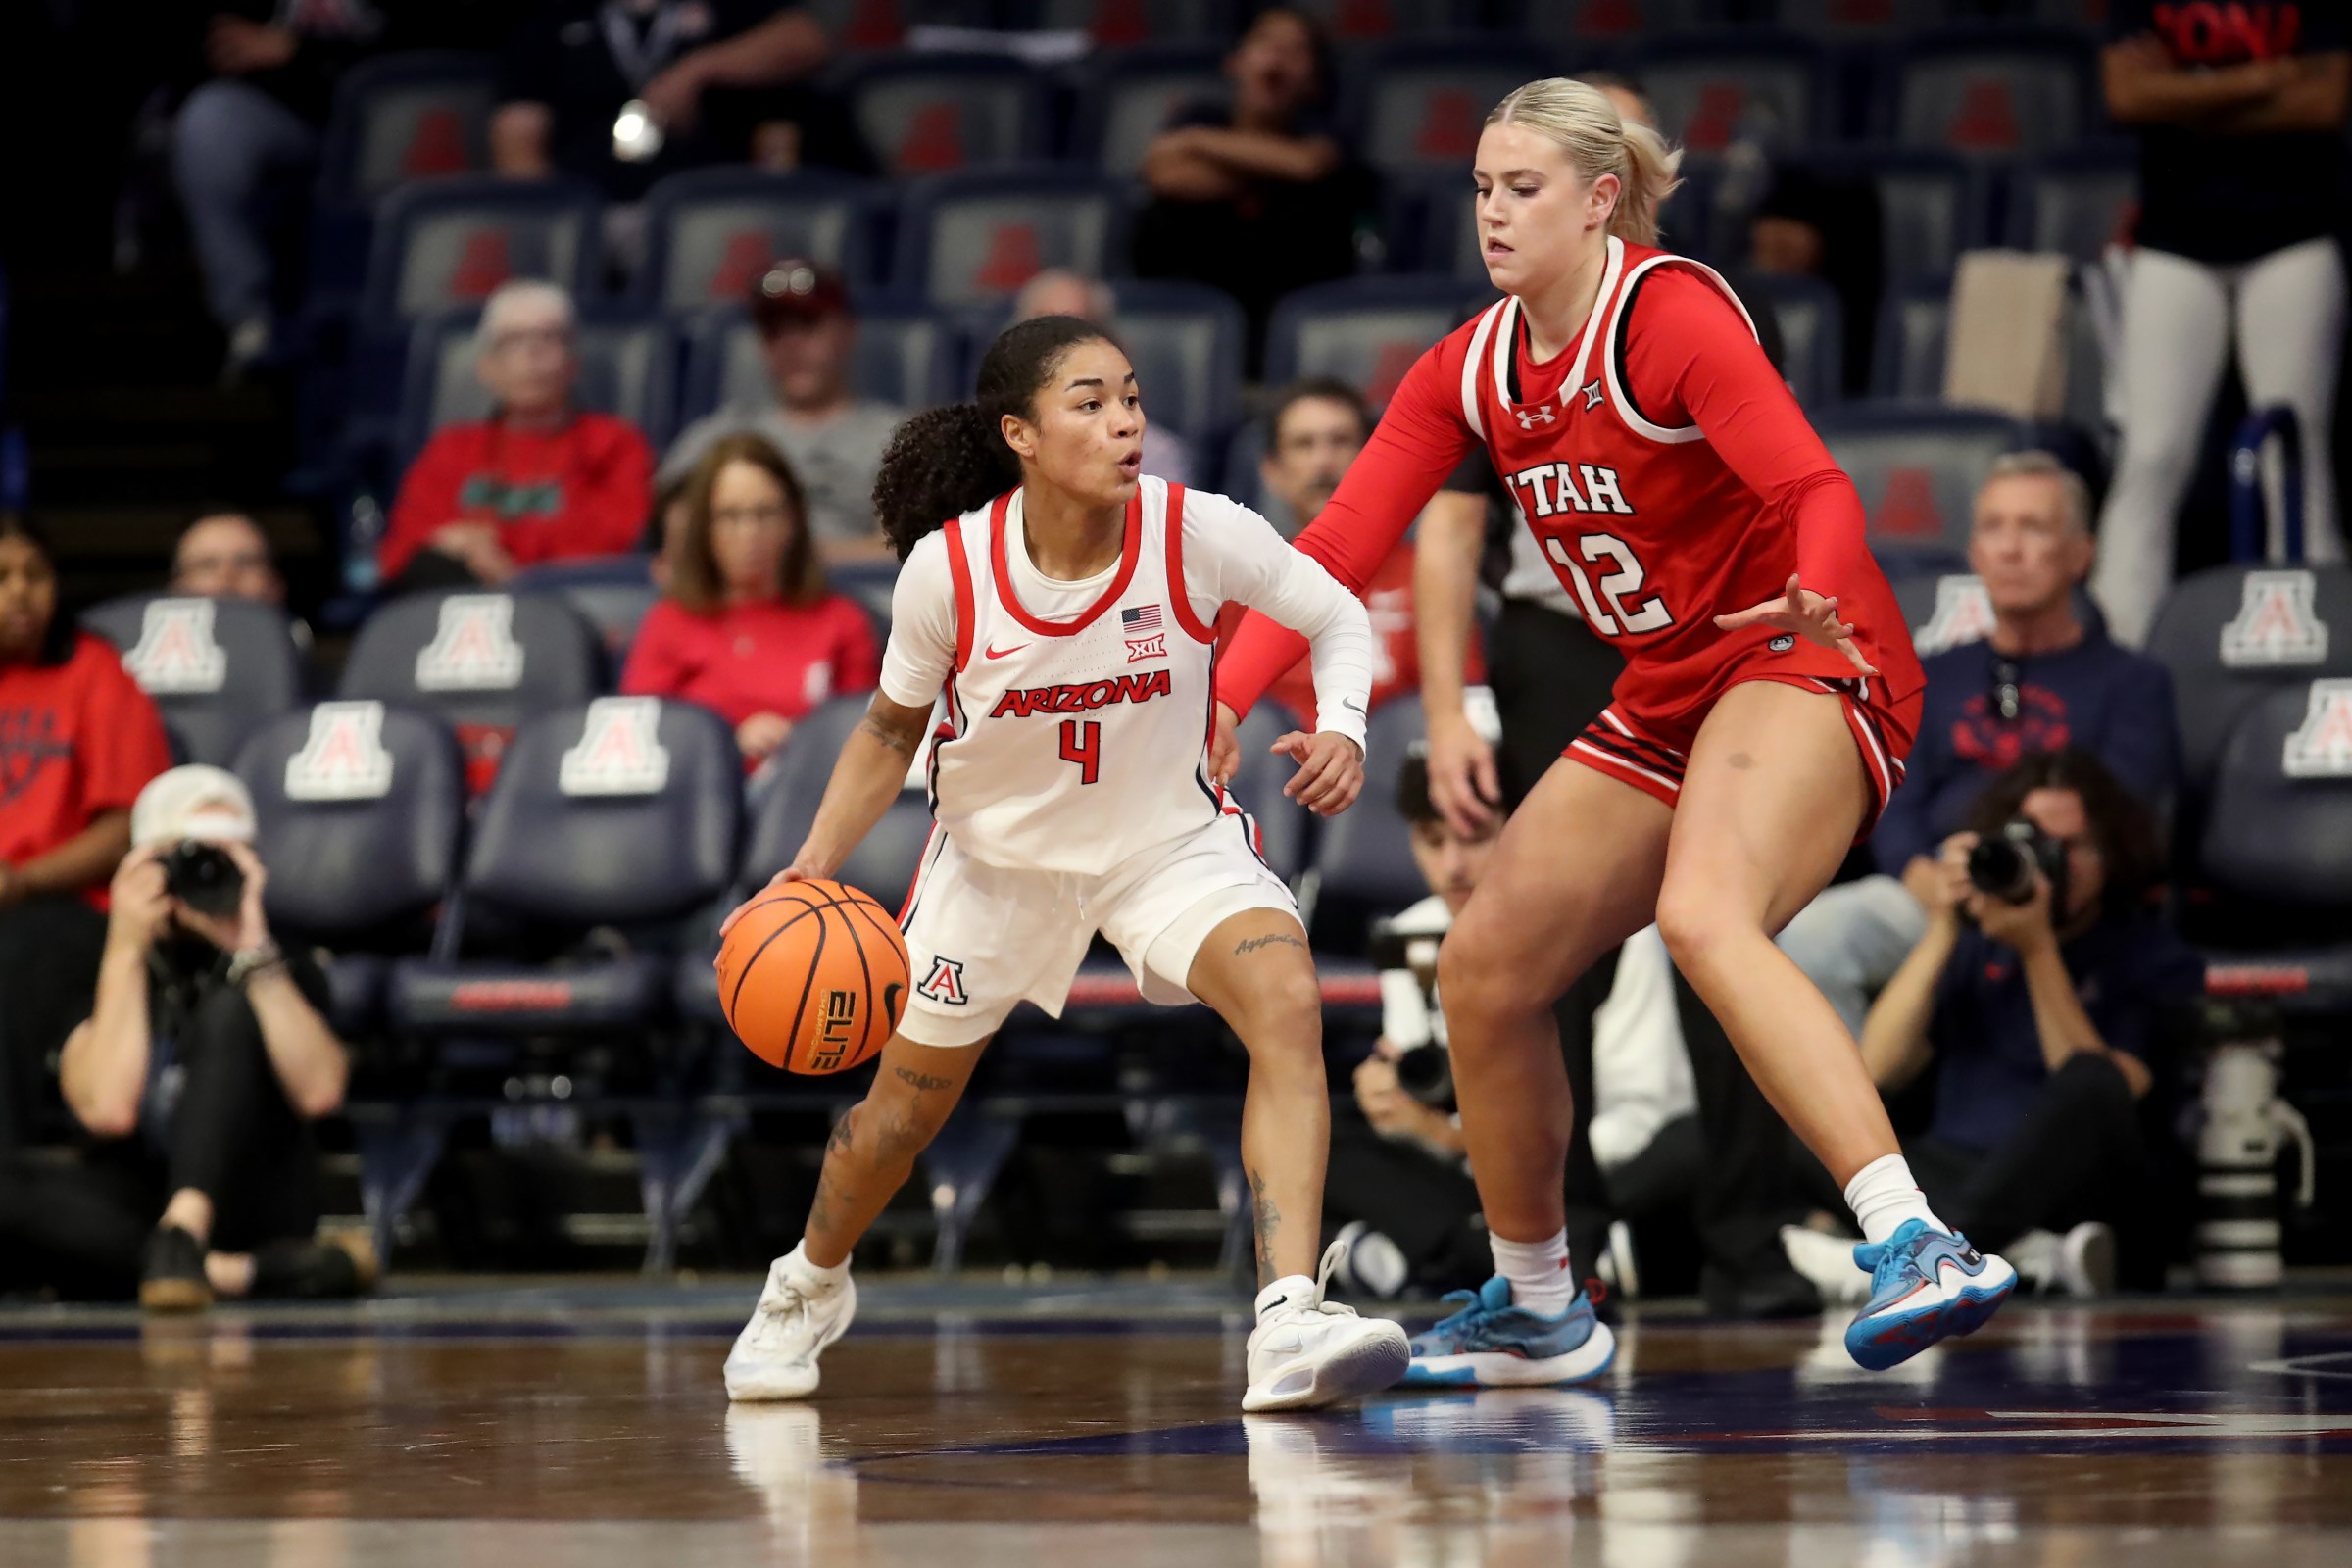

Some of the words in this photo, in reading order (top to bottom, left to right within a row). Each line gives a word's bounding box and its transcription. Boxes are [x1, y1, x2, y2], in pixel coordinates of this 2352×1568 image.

[1546, 533, 1676, 636] 12
[1127, 635, 1166, 662] XII
[989, 669, 1171, 718] ARIZONA
[1059, 719, 1101, 785] 4
[917, 955, 968, 1004] A
[811, 990, 857, 1070] ELITE
